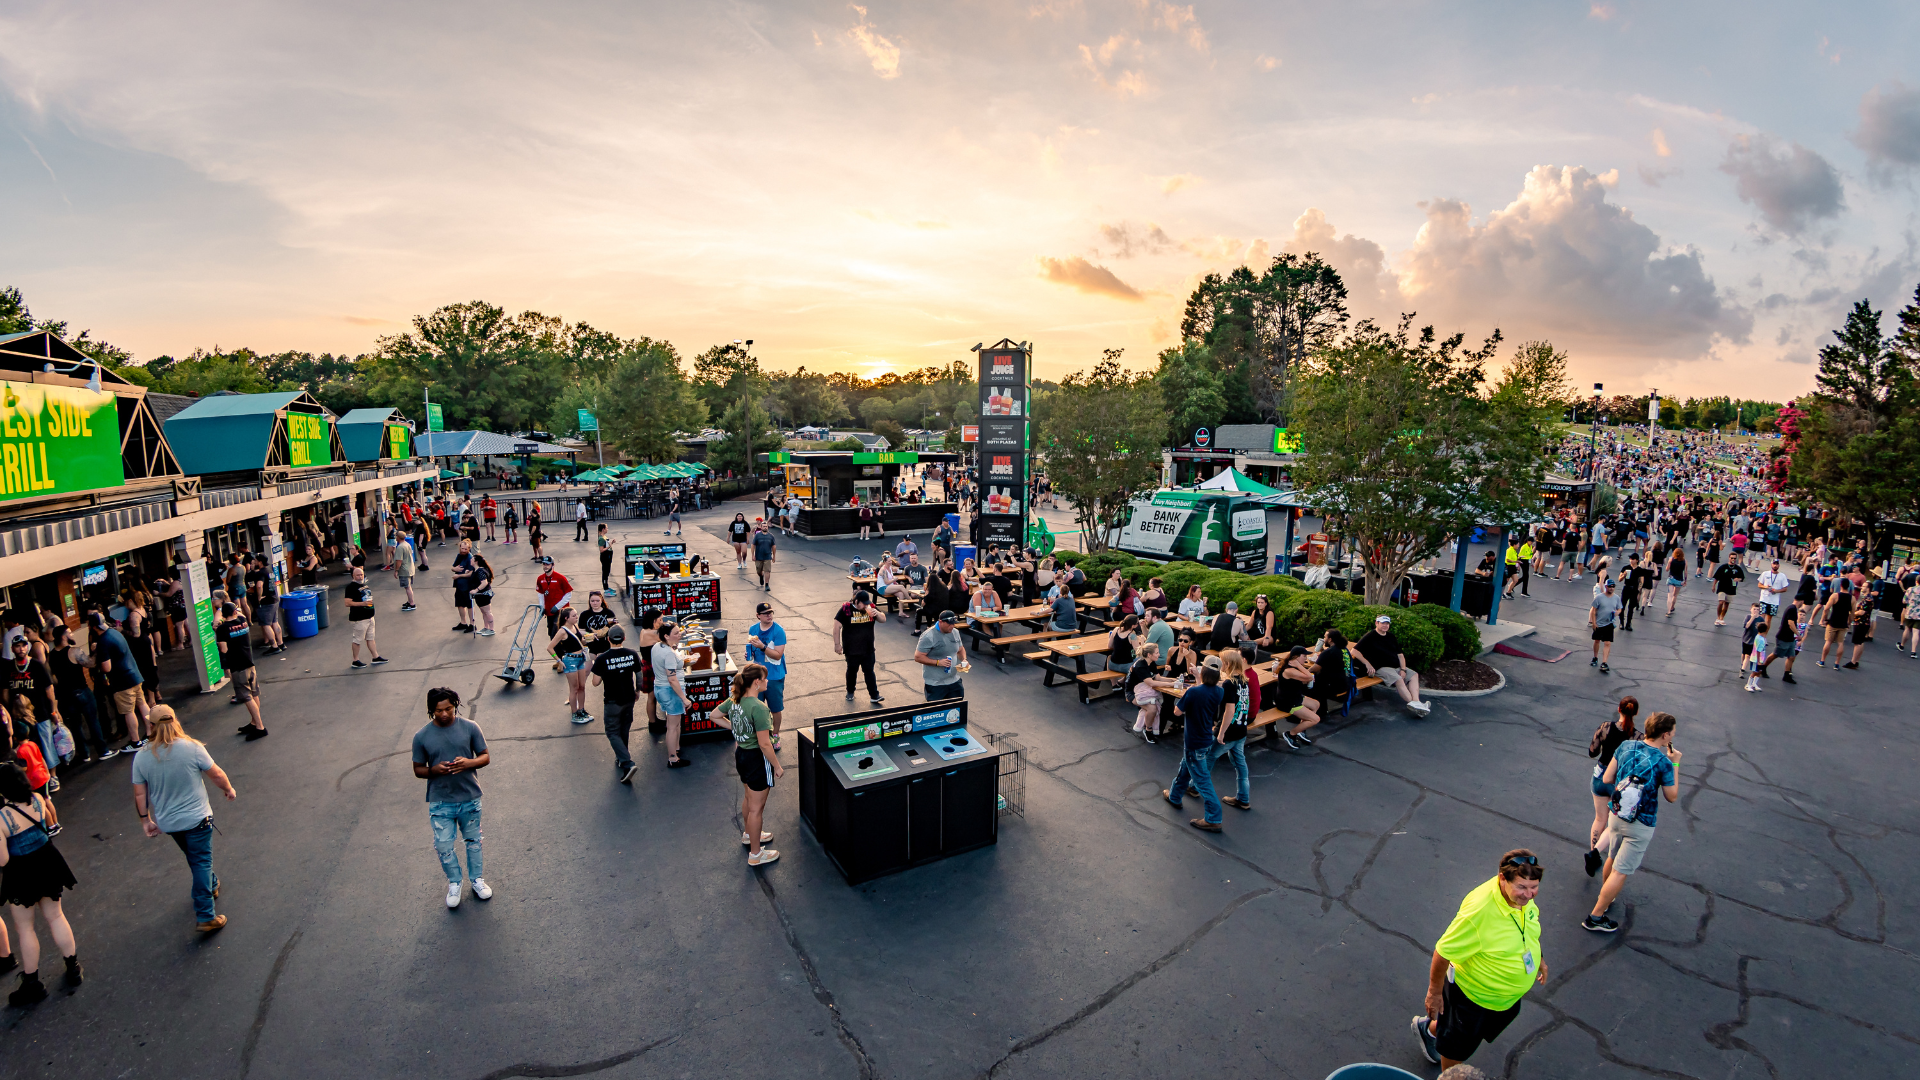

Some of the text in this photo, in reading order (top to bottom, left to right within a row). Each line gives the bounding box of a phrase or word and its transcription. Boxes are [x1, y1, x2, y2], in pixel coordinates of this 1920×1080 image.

[994, 356, 1012, 365] LIVE
[990, 364, 1014, 374] JUICE
[0, 388, 42, 438] EST
[288, 414, 322, 440] WEST SIDE
[292, 442, 311, 466] GRILL
[879, 453, 894, 462] BAR
[993, 456, 1011, 465] LIVE
[990, 465, 1013, 474] JUICE
[1154, 510, 1182, 522] BANK
[1140, 521, 1176, 535] BETTER
[298, 614, 315, 622] RECYCLE
[610, 655, 634, 663] SWEAR
[25, 679, 34, 689] 41
[838, 728, 863, 736] COMPOST
